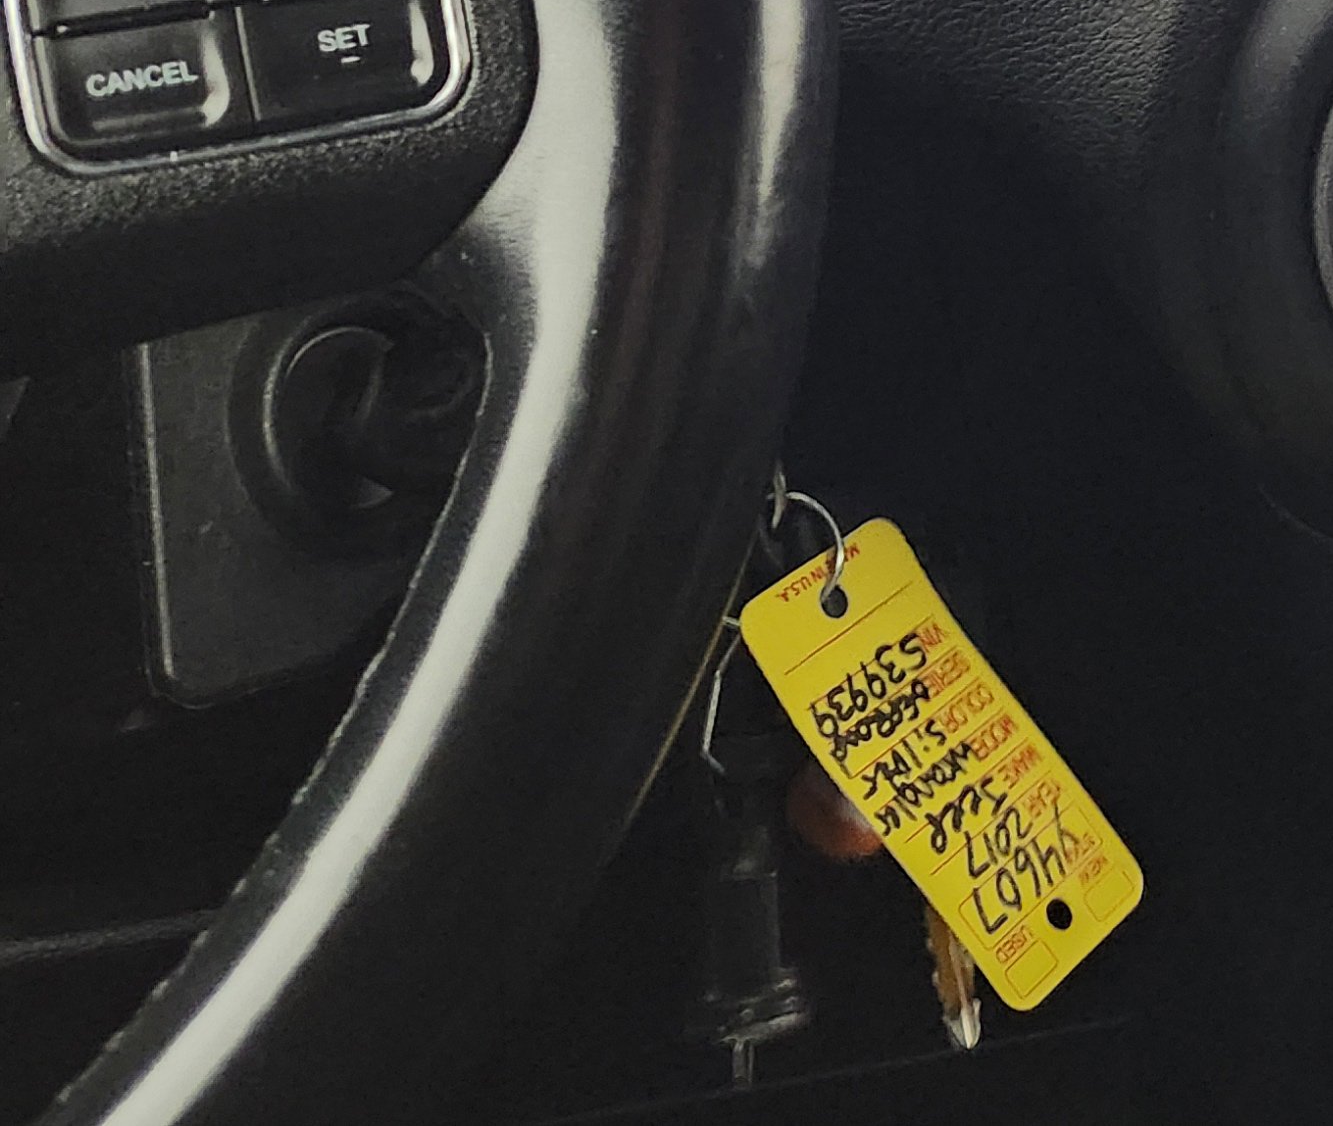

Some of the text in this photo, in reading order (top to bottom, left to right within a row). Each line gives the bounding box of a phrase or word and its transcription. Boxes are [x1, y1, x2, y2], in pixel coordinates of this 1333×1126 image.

[317, 23, 371, 53] SET
[85, 60, 199, 98] CANCEL
[809, 565, 826, 581] IN
[917, 622, 948, 654] VIN
[963, 807, 1034, 880] 2017
[992, 924, 1033, 965] USED
